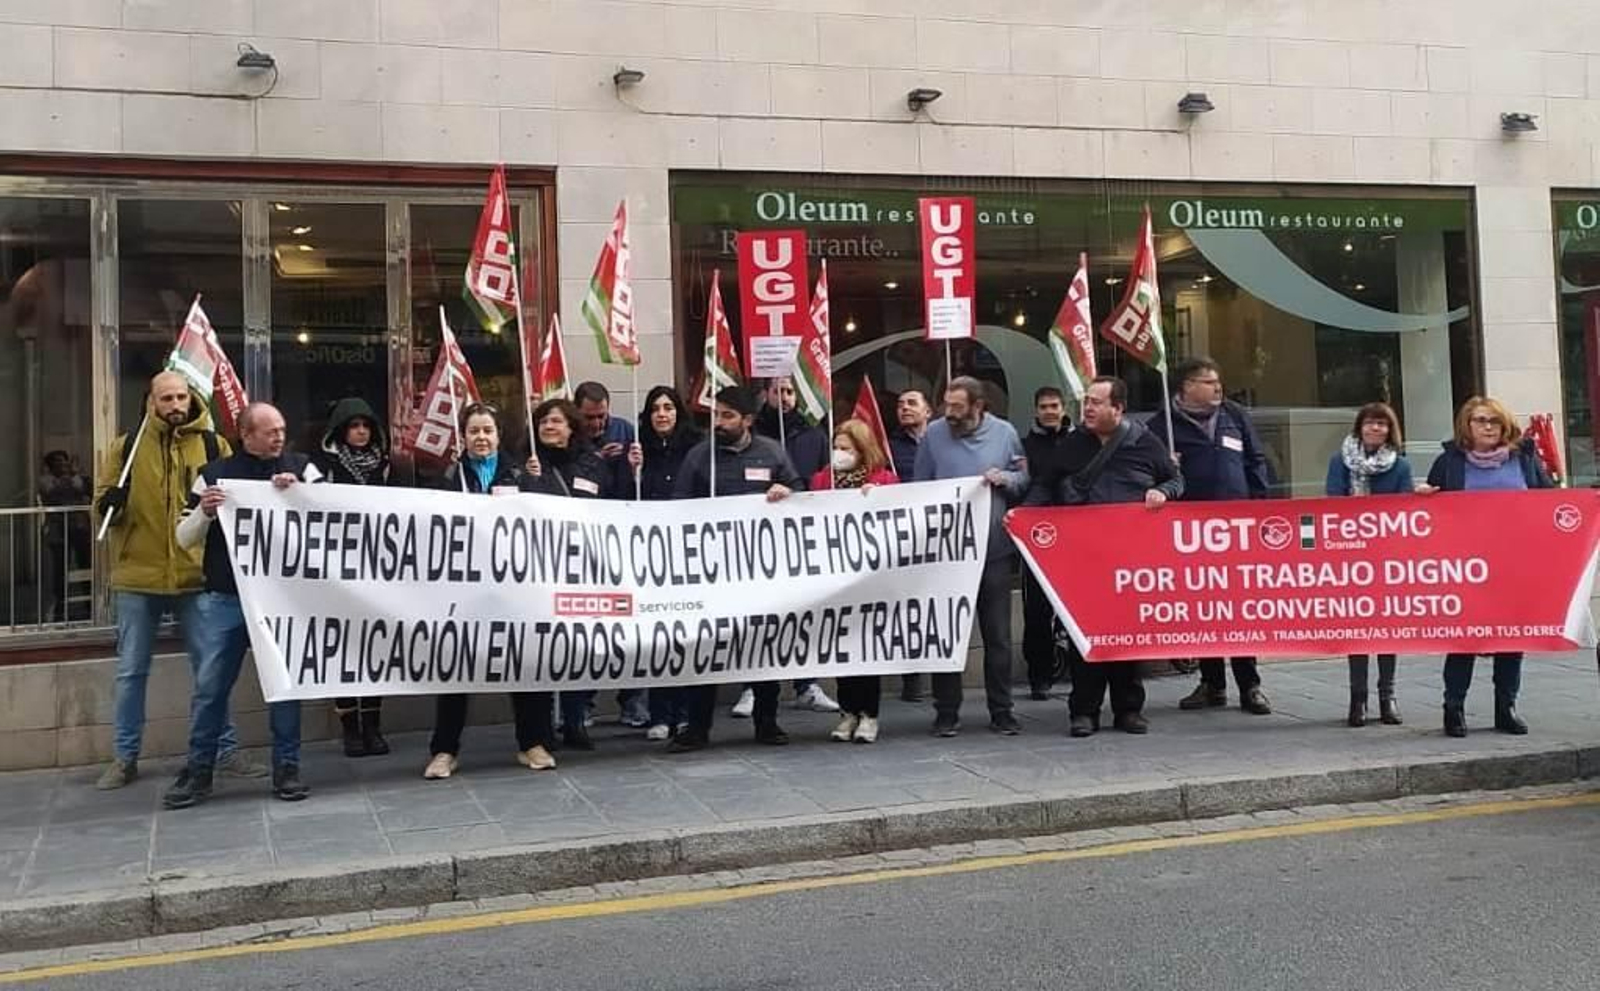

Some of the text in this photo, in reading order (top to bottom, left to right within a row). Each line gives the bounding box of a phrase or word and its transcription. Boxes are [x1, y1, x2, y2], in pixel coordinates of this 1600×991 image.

[756, 192, 1034, 225] Oleum resante
[1170, 200, 1404, 229] Oleum restaurante
[930, 205, 963, 299] UGT
[752, 238, 795, 336] UGT
[235, 486, 978, 587] EN DEFENSA DEL CONVENIO COLECTIVO DE HOSTELERÍA
[1173, 510, 1432, 553] UGT FeSMC
[1324, 539, 1366, 550] Granada
[1115, 558, 1488, 593] POR UN TRABAJO DIGNO
[557, 597, 613, 612] CCOO
[639, 600, 704, 613] servicios
[1139, 595, 1462, 623] POR UN CONVENIO JUSTO
[298, 603, 480, 684] APLICACIÓN
[486, 620, 526, 682] EN
[534, 620, 625, 681] TODOS
[632, 619, 687, 678] LOS
[693, 611, 813, 672] CENTROS
[817, 604, 853, 664] DE
[1136, 633, 1152, 645] DE
[1155, 631, 1217, 645] TODOS/AS
[1223, 630, 1266, 643] LOS/AS
[1273, 627, 1389, 641] TRABAJADORES/AS
[1392, 627, 1417, 638] UGT
[1421, 627, 1463, 638] LUCHA
[1467, 626, 1492, 638] POR
[1496, 625, 1521, 637] TUS
[1523, 625, 1565, 637] DEREC
